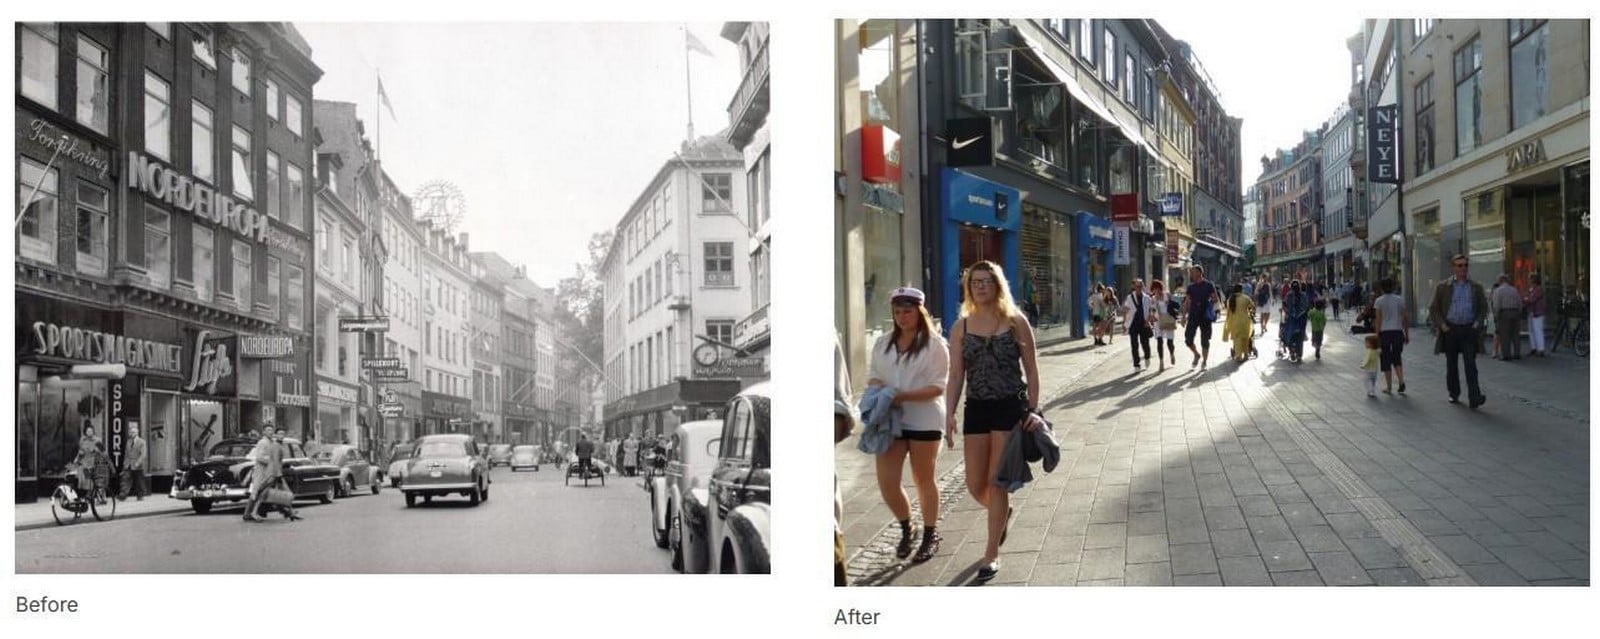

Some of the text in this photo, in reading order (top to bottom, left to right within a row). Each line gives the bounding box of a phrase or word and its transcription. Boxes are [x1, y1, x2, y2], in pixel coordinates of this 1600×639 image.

[1376, 110, 1392, 178] NEYE
[1506, 138, 1547, 173] ZARA
[129, 151, 269, 243] NORDEUROPA
[33, 322, 182, 372] SPORTSMAGASINET
[113, 384, 122, 467] SPORT
